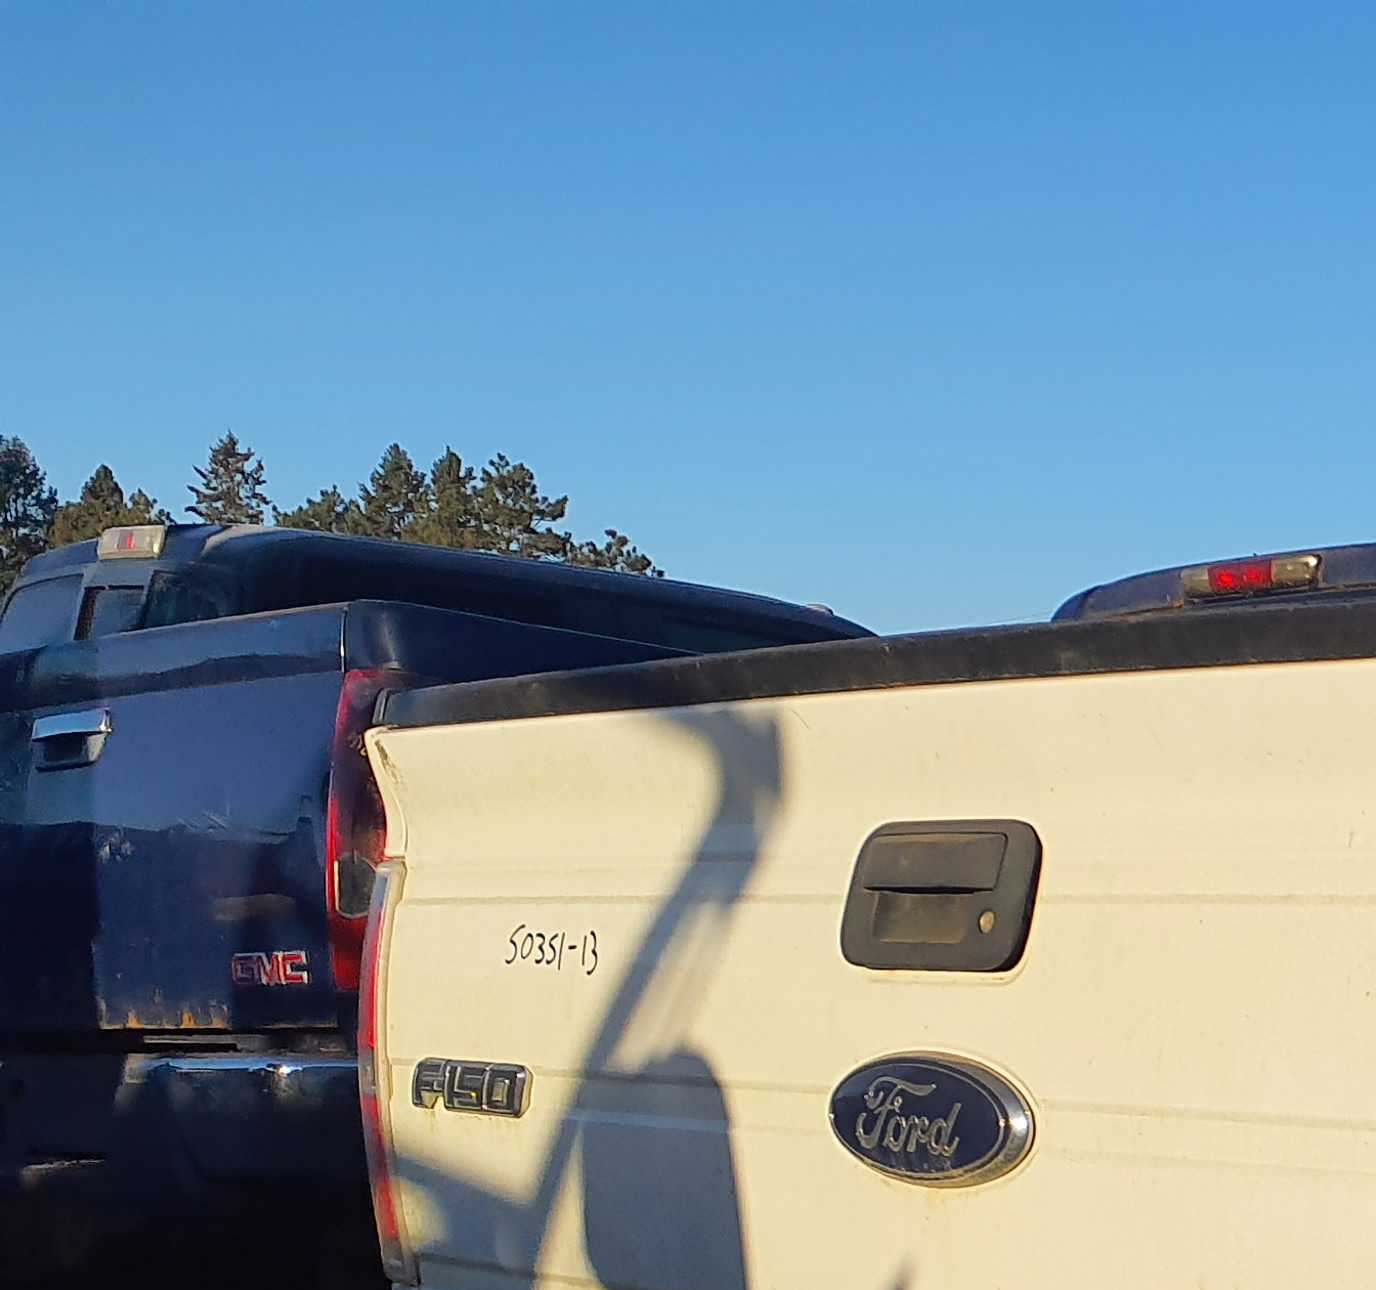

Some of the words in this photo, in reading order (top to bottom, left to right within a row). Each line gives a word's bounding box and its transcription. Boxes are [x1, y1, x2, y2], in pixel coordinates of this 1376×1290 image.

[231, 950, 308, 986] GMC
[504, 923, 598, 976] 50351-13
[856, 1076, 961, 1156] Ford
